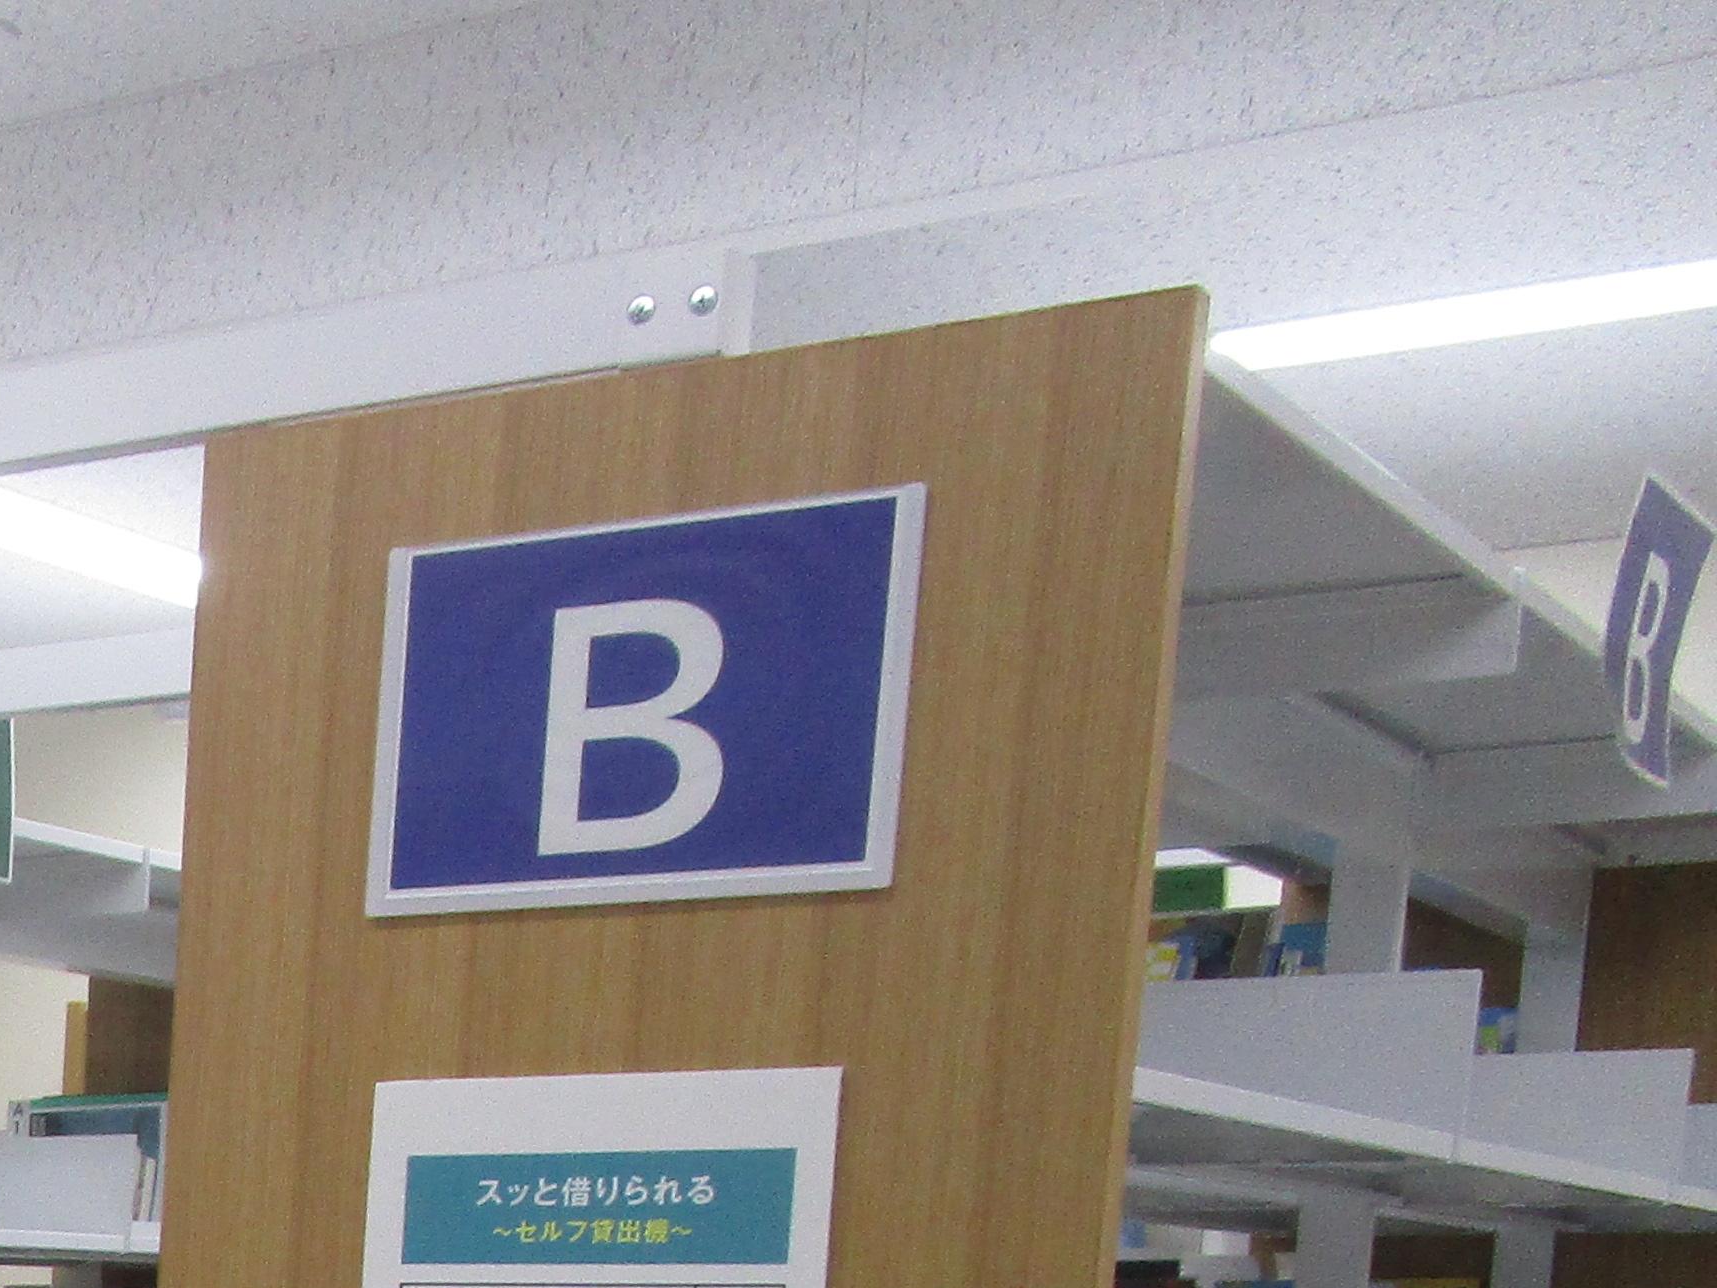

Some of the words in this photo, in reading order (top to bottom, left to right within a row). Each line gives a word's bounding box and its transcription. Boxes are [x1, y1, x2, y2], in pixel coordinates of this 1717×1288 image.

[537, 598, 725, 856] B
[1621, 551, 1669, 744] B
[475, 1174, 716, 1208] スッと借りられる
